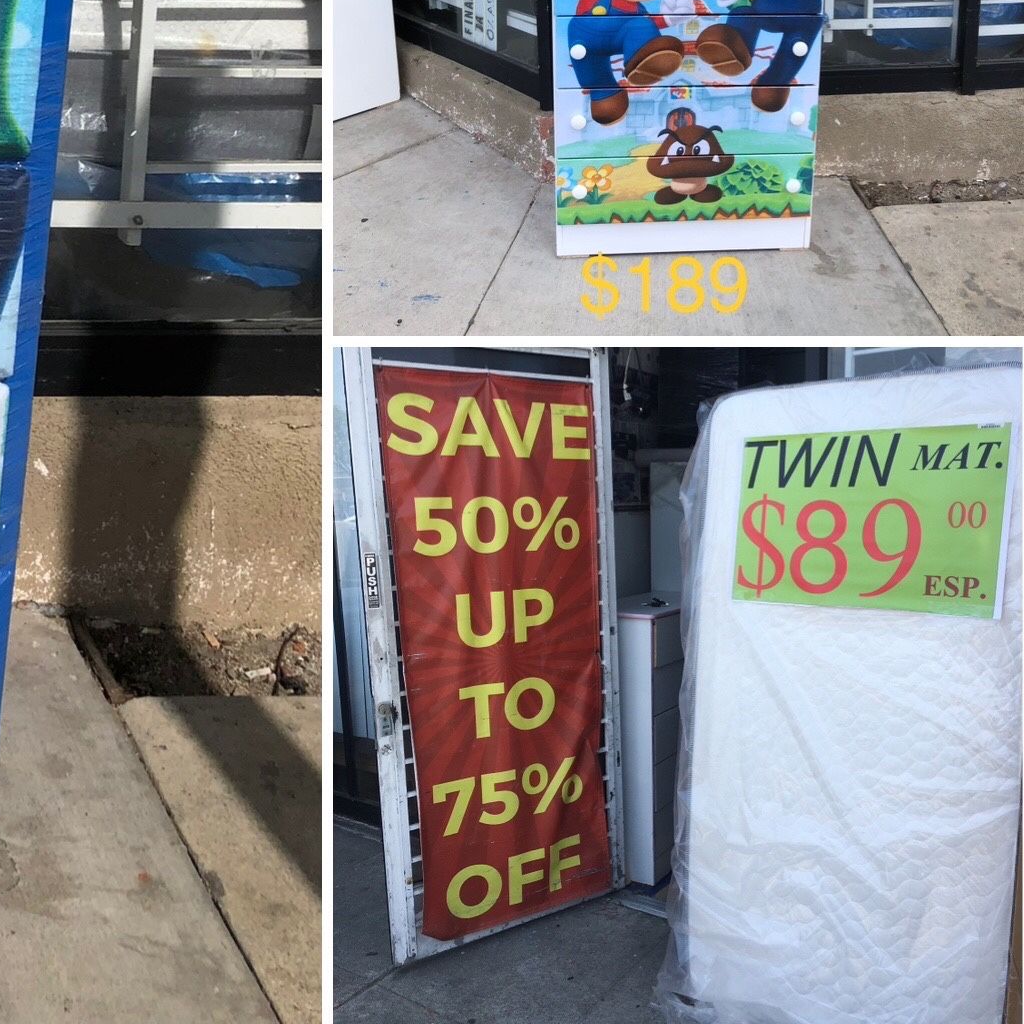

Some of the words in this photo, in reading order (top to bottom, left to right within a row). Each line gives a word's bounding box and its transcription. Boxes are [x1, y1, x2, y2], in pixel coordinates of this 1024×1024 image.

[387, 392, 591, 460] SAVE
[744, 432, 901, 489] TWIN
[910, 441, 1004, 471] MAT.
[413, 495, 580, 557] 50%
[737, 493, 922, 599] $89
[947, 501, 987, 529] 00
[366, 557, 378, 596] PUSH
[923, 574, 987, 600] ESP.
[455, 588, 555, 649] UP
[458, 676, 556, 739] TO
[432, 756, 583, 837] 75%
[446, 833, 581, 919] OFF
